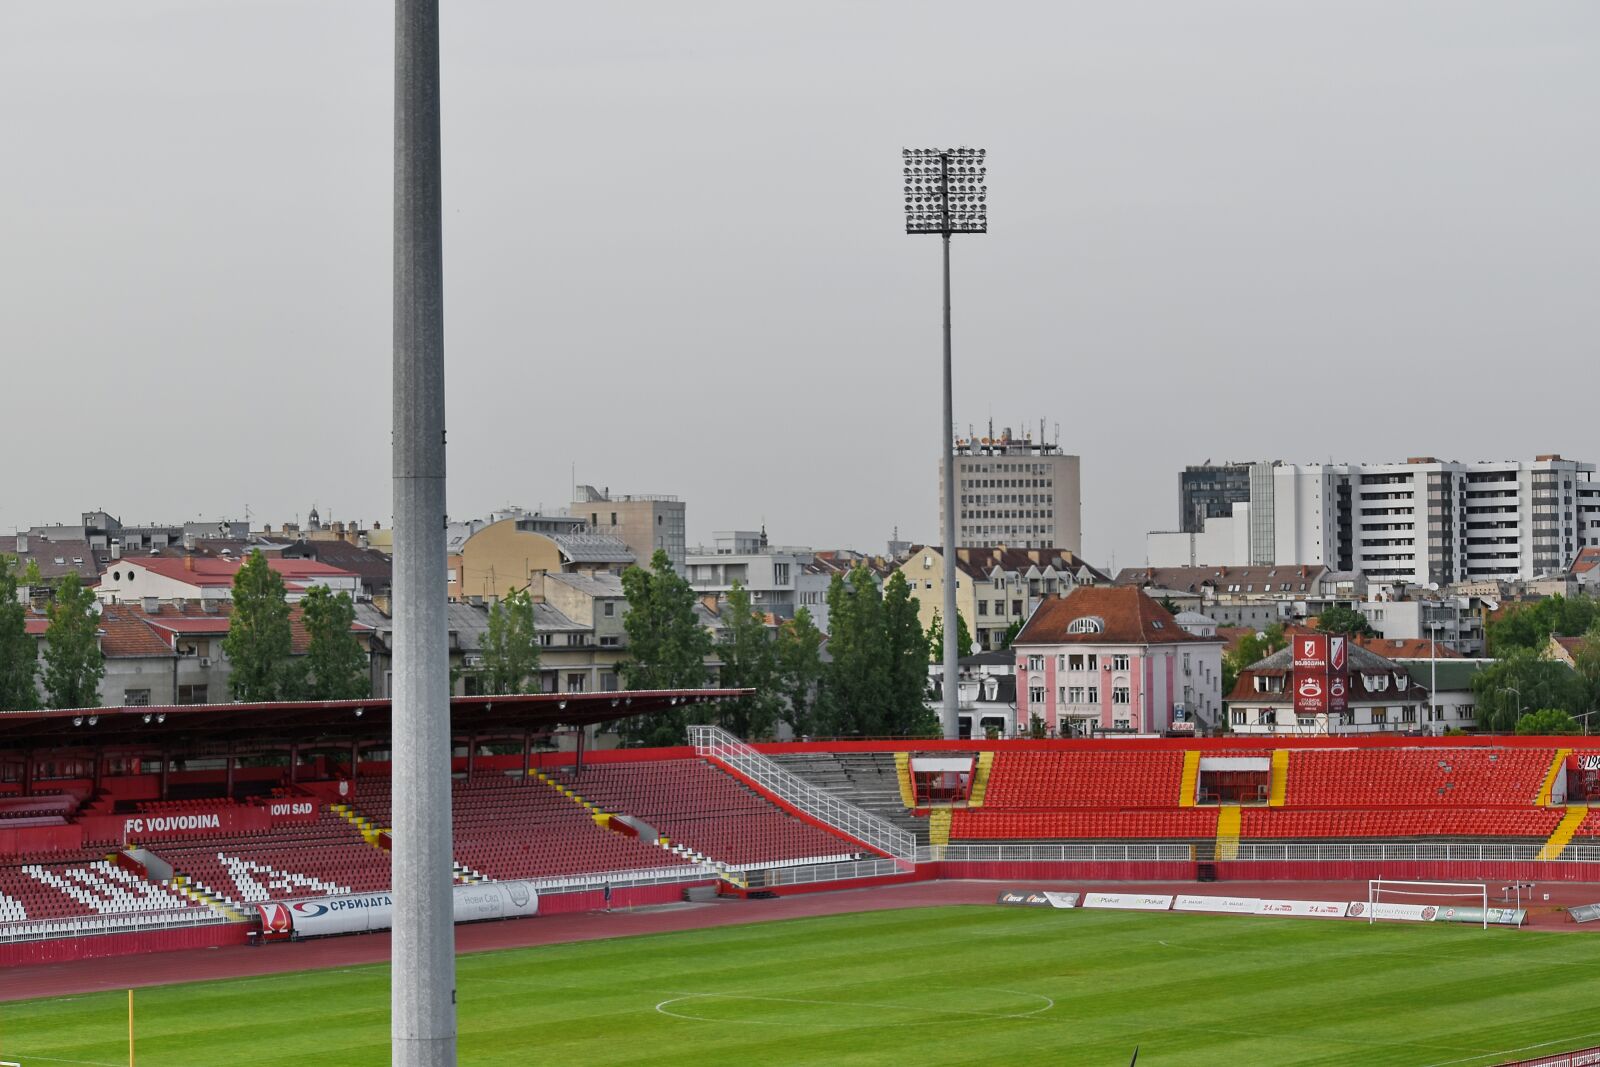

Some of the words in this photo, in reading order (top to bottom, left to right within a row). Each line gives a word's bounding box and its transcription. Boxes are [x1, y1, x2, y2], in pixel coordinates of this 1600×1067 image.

[292, 803, 313, 814] SAD
[126, 819, 143, 833] FC
[146, 814, 220, 832] VOJVODINA
